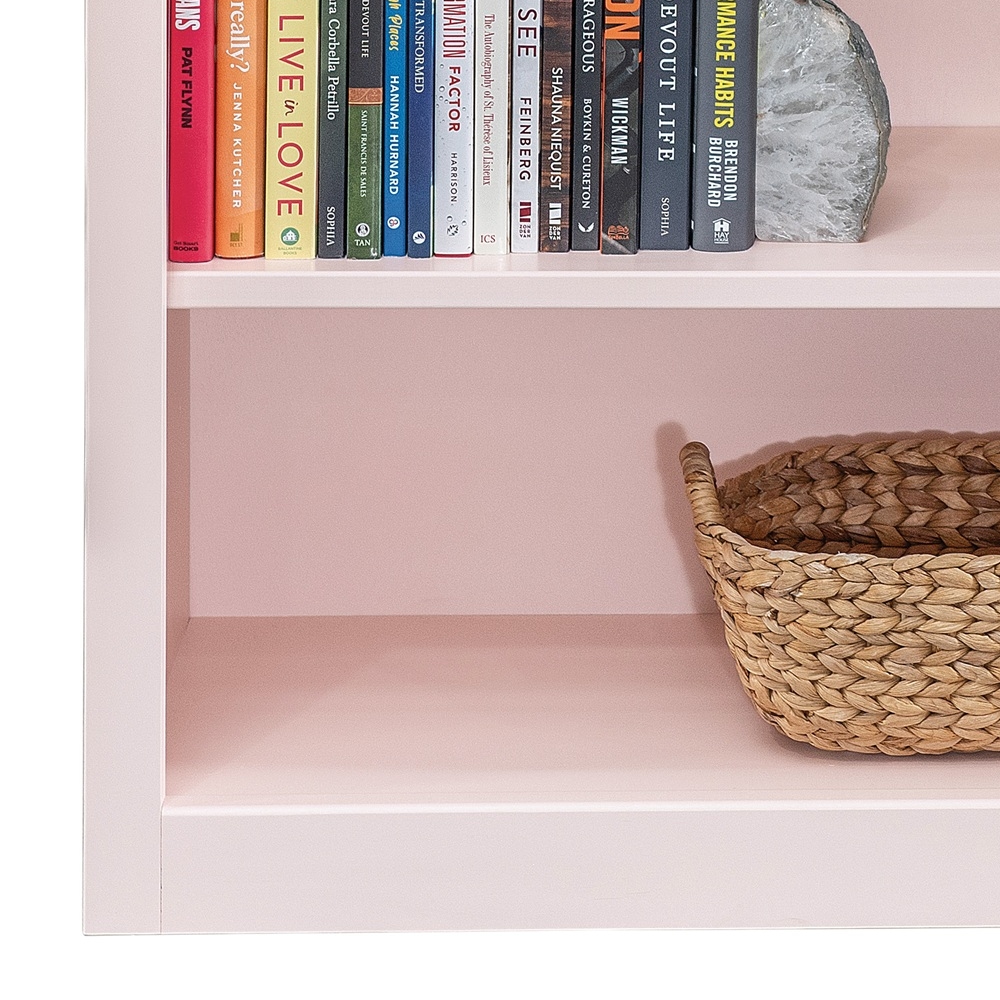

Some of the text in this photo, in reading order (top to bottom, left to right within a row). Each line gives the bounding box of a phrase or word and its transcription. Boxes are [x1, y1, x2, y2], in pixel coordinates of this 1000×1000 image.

[226, 1, 251, 73] really?
[327, 18, 341, 72] Corbella
[361, 0, 370, 37] DEVOUT
[388, 14, 403, 51] Places
[414, 0, 425, 94] TRANSFORMED
[517, 8, 537, 58] SEE
[361, 44, 370, 58] LIFE
[181, 47, 193, 129] PAT FLYNN
[277, 15, 305, 216] LIVE in LOVE
[326, 76, 340, 120] Petrillo
[448, 66, 461, 132] FACTOR
[481, 13, 496, 186] The Autobiography of St. Thérèse of Lisieux
[714, 67, 735, 128] HABITS
[232, 82, 242, 209] JENNA KUTCHER
[360, 109, 368, 131] SAINT
[360, 133, 368, 164] FRANCIS
[389, 75, 400, 195] HANNAH HURNARD
[519, 97, 532, 180] FEINBERG
[549, 67, 563, 191] SHAUNA NIEQUIST
[610, 97, 629, 165] WICKMAN
[657, 103, 676, 161] LIFE
[360, 165, 367, 174] DE
[582, 98, 592, 209] BOYKIN & CURETON
[707, 137, 723, 208] BURCHARD
[723, 139, 739, 201] BRENDON
[326, 206, 336, 246] SOPHIA
[354, 238, 371, 247] TAN
[480, 234, 496, 243] ICS
[660, 197, 670, 236] SOPHIA
